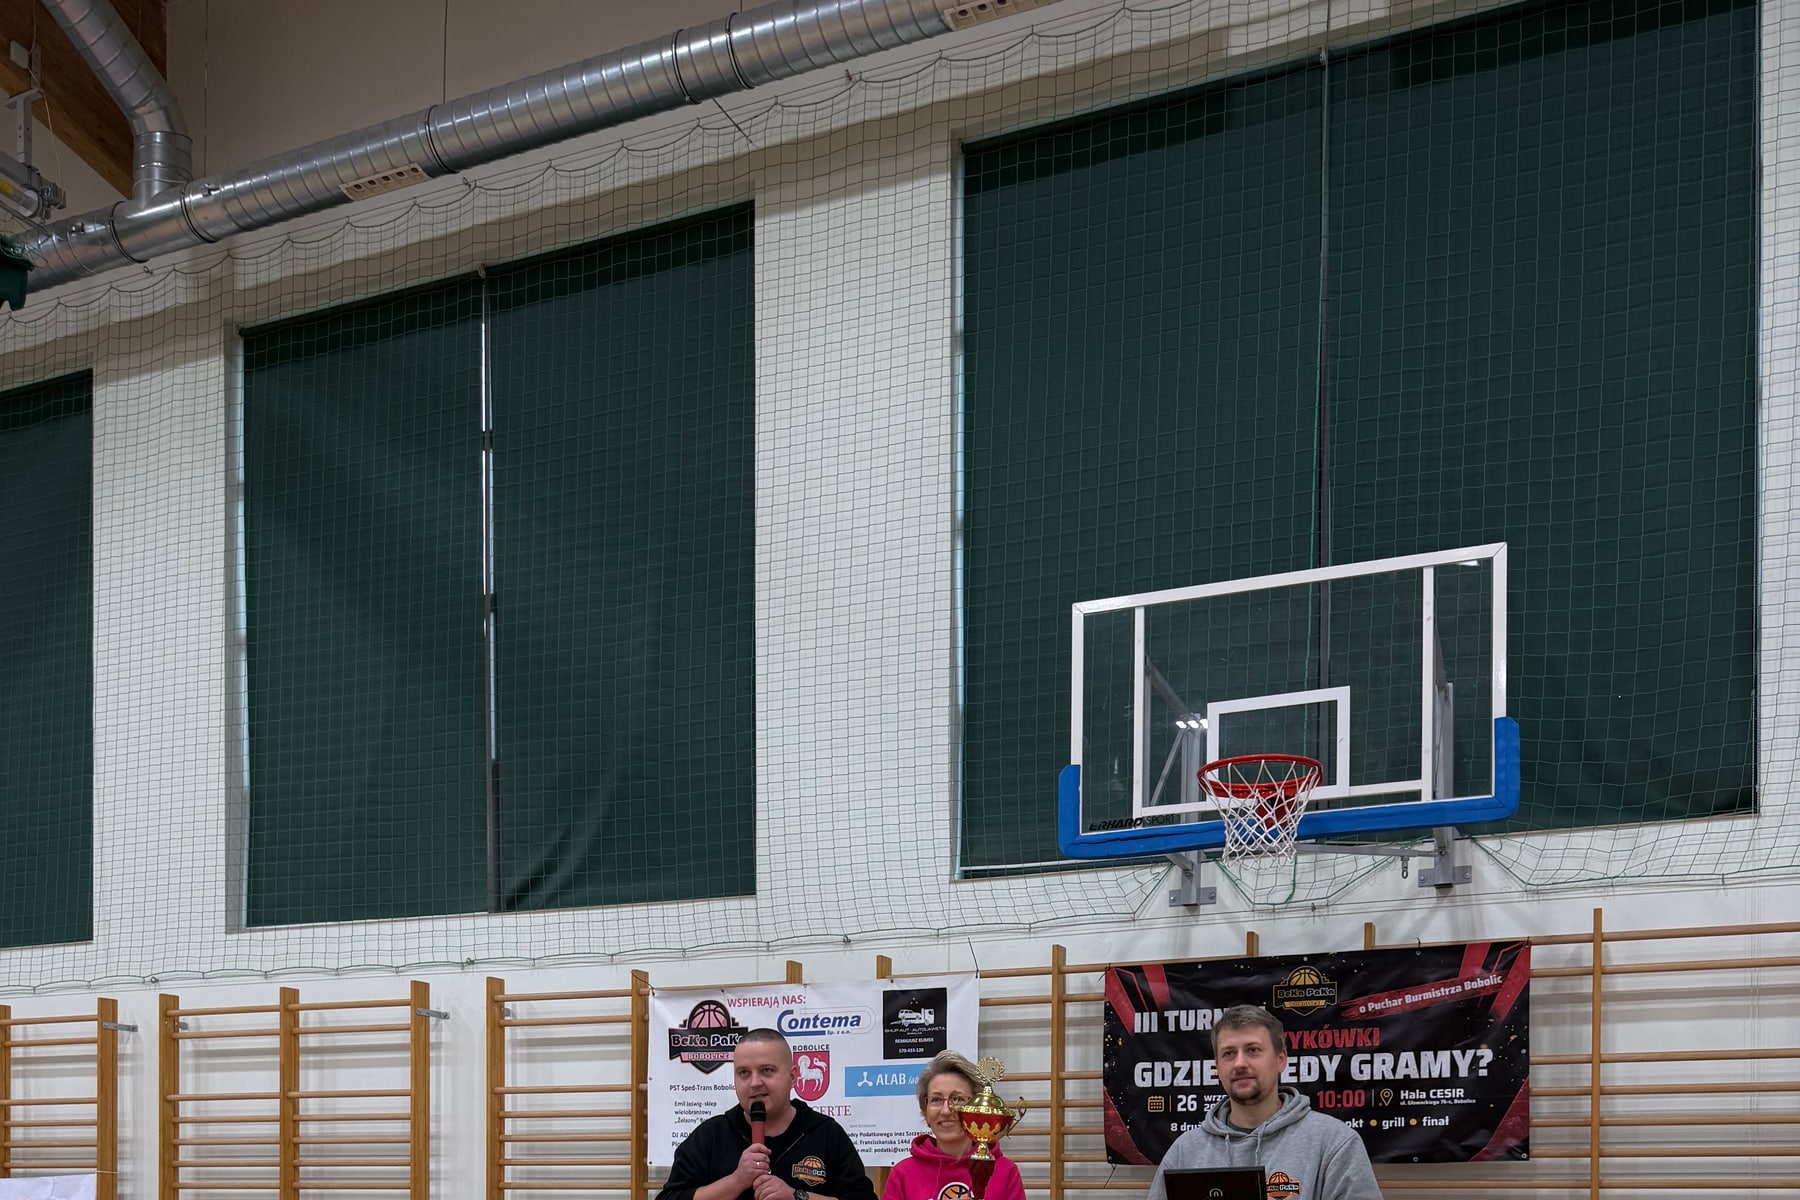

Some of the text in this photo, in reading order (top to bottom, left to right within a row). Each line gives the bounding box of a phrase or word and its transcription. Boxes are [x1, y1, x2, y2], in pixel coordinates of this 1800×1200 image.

[1146, 814, 1175, 826] SPORT
[1359, 974, 1503, 1013] o Puchar Burmistrza Bobolic
[727, 995, 806, 1009] WSPIERAJĄ NAS:
[777, 1010, 862, 1037] Contema
[1134, 1011, 1158, 1034] III
[671, 1034, 708, 1047] BeKa
[1283, 1024, 1380, 1050] YKÓWKI
[792, 1044, 830, 1052] BOBOLICE
[1134, 1060, 1220, 1088] GDZIE
[1350, 1049, 1494, 1081] GRAMY?
[876, 1073, 906, 1086] ALAB
[1317, 1088, 1366, 1108] 10:00
[1400, 1088, 1465, 1099] Hala CESIR
[1177, 1094, 1197, 1112] 26
[1171, 1122, 1178, 1131] 8
[1382, 1117, 1405, 1130] grill
[1422, 1116, 1449, 1127] finał
